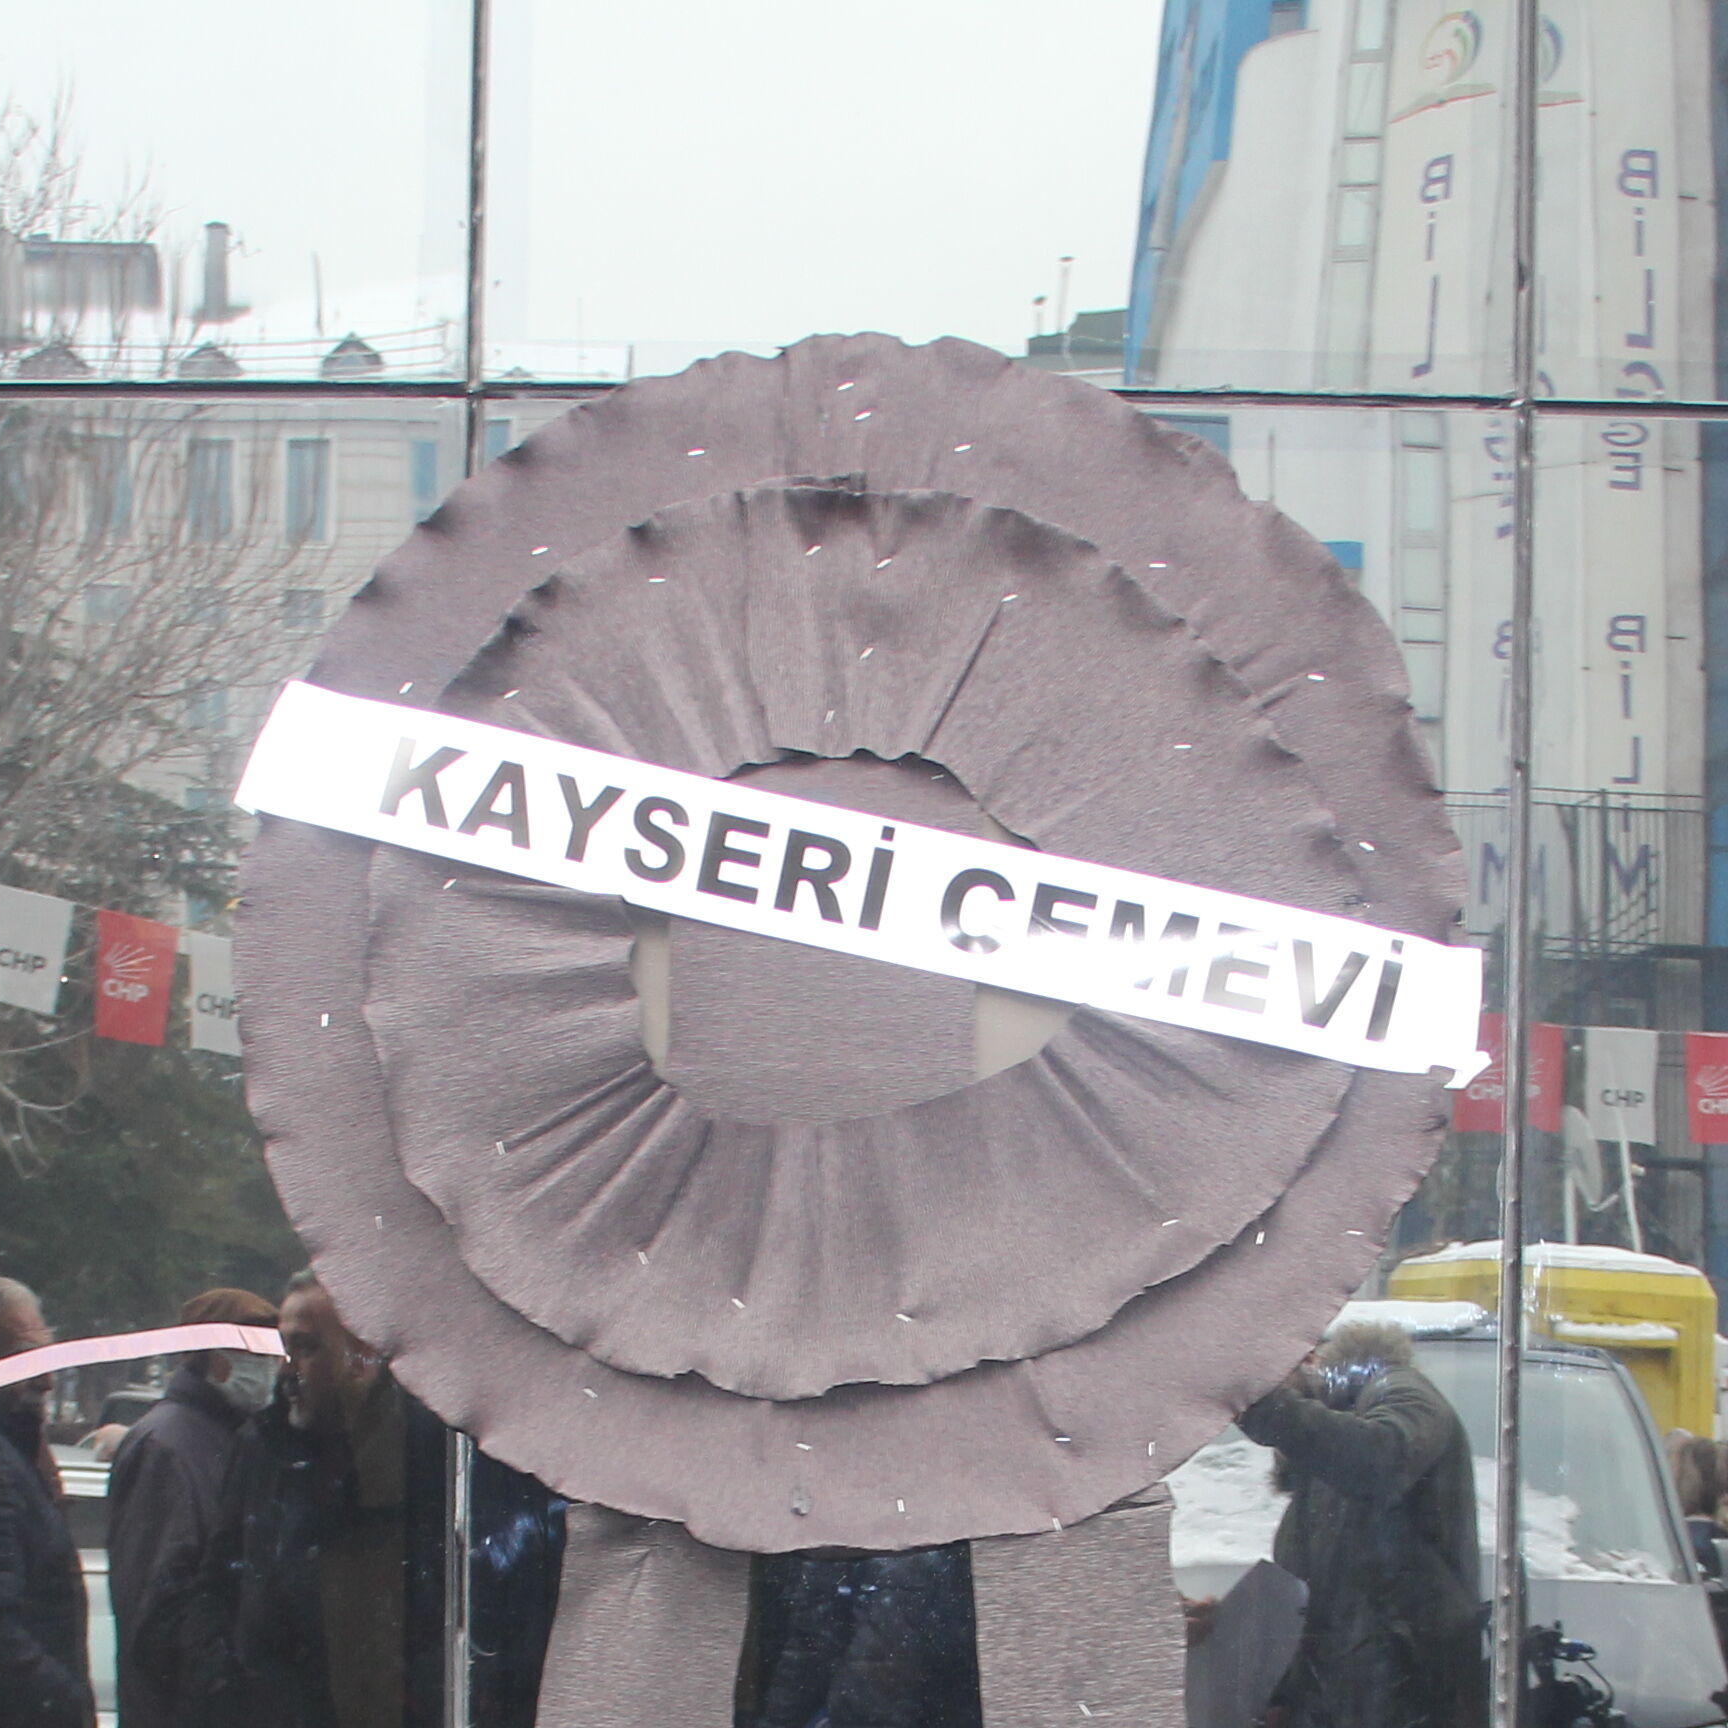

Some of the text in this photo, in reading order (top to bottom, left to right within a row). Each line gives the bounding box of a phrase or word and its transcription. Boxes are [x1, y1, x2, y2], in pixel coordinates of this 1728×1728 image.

[378, 736, 896, 932] KAYSERİ
[102, 977, 152, 1003] CHP
[1601, 1088, 1645, 1109] CHP
